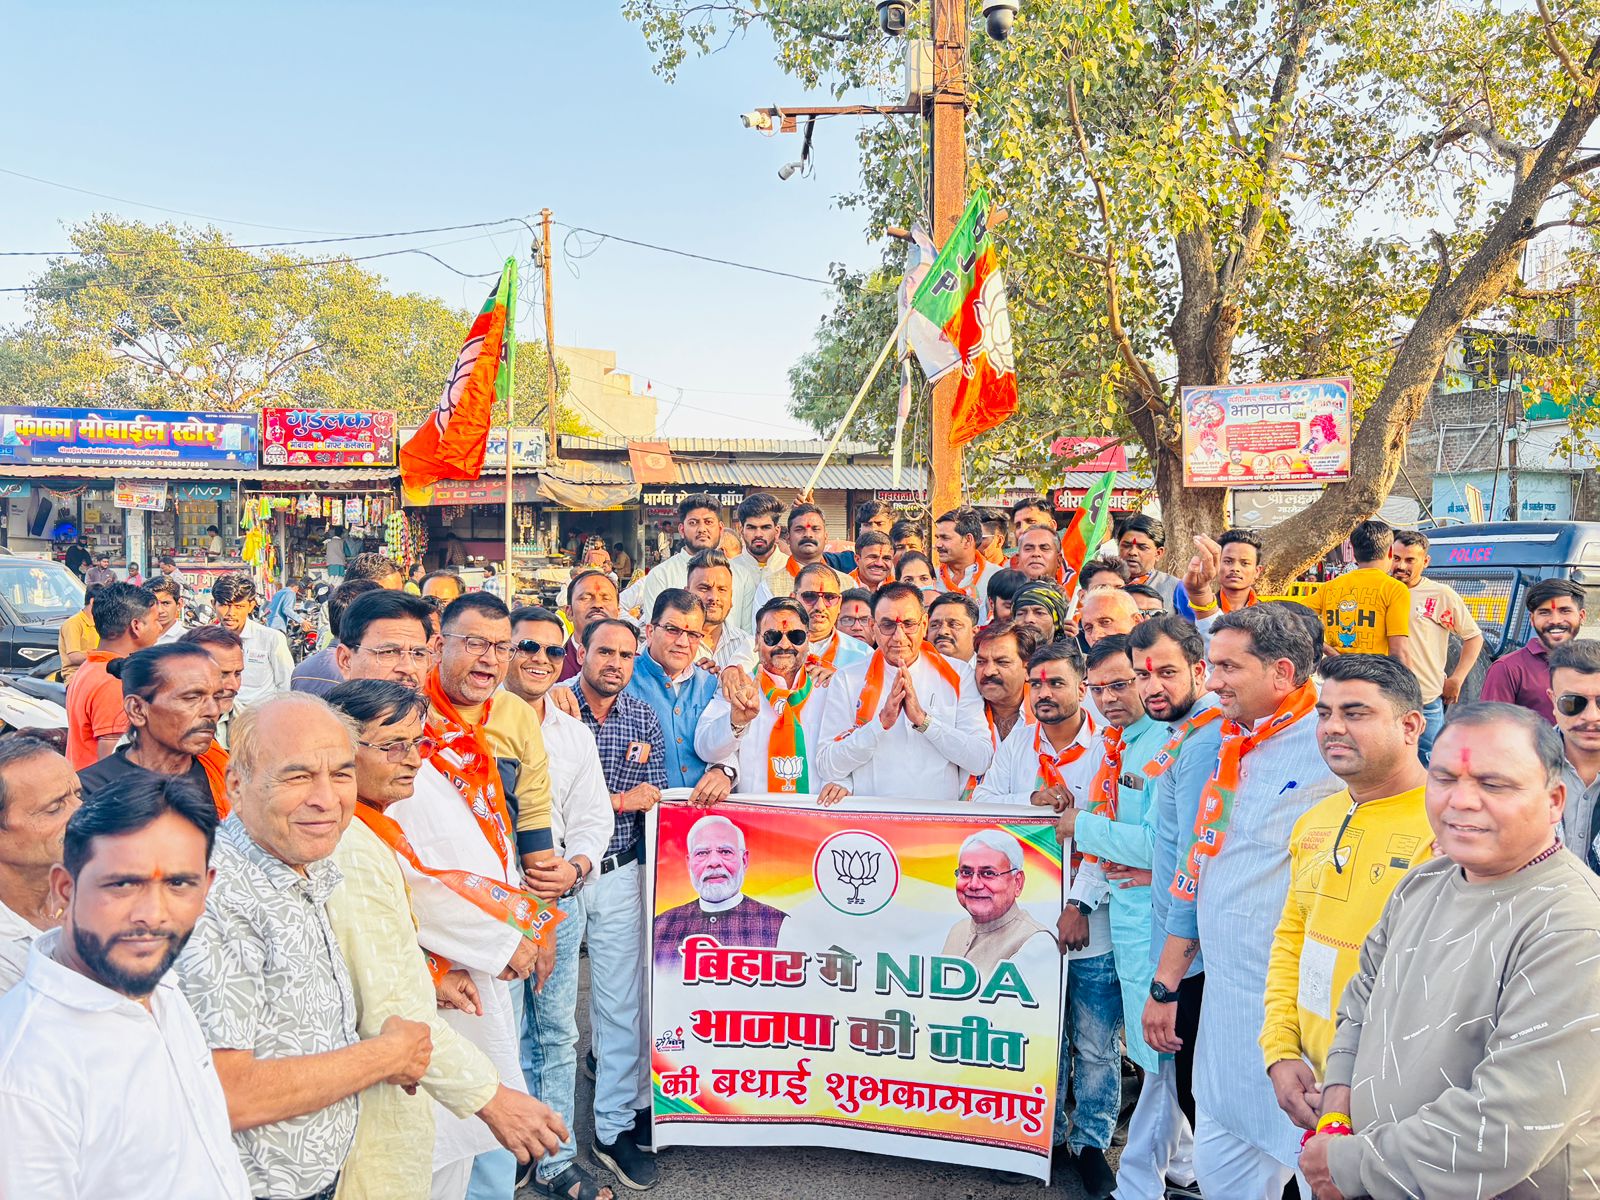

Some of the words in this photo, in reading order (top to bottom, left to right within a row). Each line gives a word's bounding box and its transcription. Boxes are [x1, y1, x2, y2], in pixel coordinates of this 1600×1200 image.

[1231, 402, 1292, 418] भागवत
[15, 418, 73, 437] काका
[78, 413, 167, 442] मोबाईल
[171, 416, 218, 442] स्टोर
[286, 410, 372, 436] गुडलक
[183, 485, 222, 496] vivo
[643, 490, 675, 506] भार्गव
[721, 490, 744, 506] शॉप
[1268, 491, 1283, 505] श्री
[1449, 547, 1492, 562] POLICE
[680, 936, 809, 985] बिहार
[876, 952, 1036, 1005] NDA
[690, 1009, 837, 1048] भाजपा
[847, 1008, 917, 1056] की
[928, 1015, 1027, 1068] जीत
[662, 1065, 699, 1096] की
[711, 1058, 811, 1104] बधाई
[826, 1072, 1046, 1133] शुभकामनाएं
